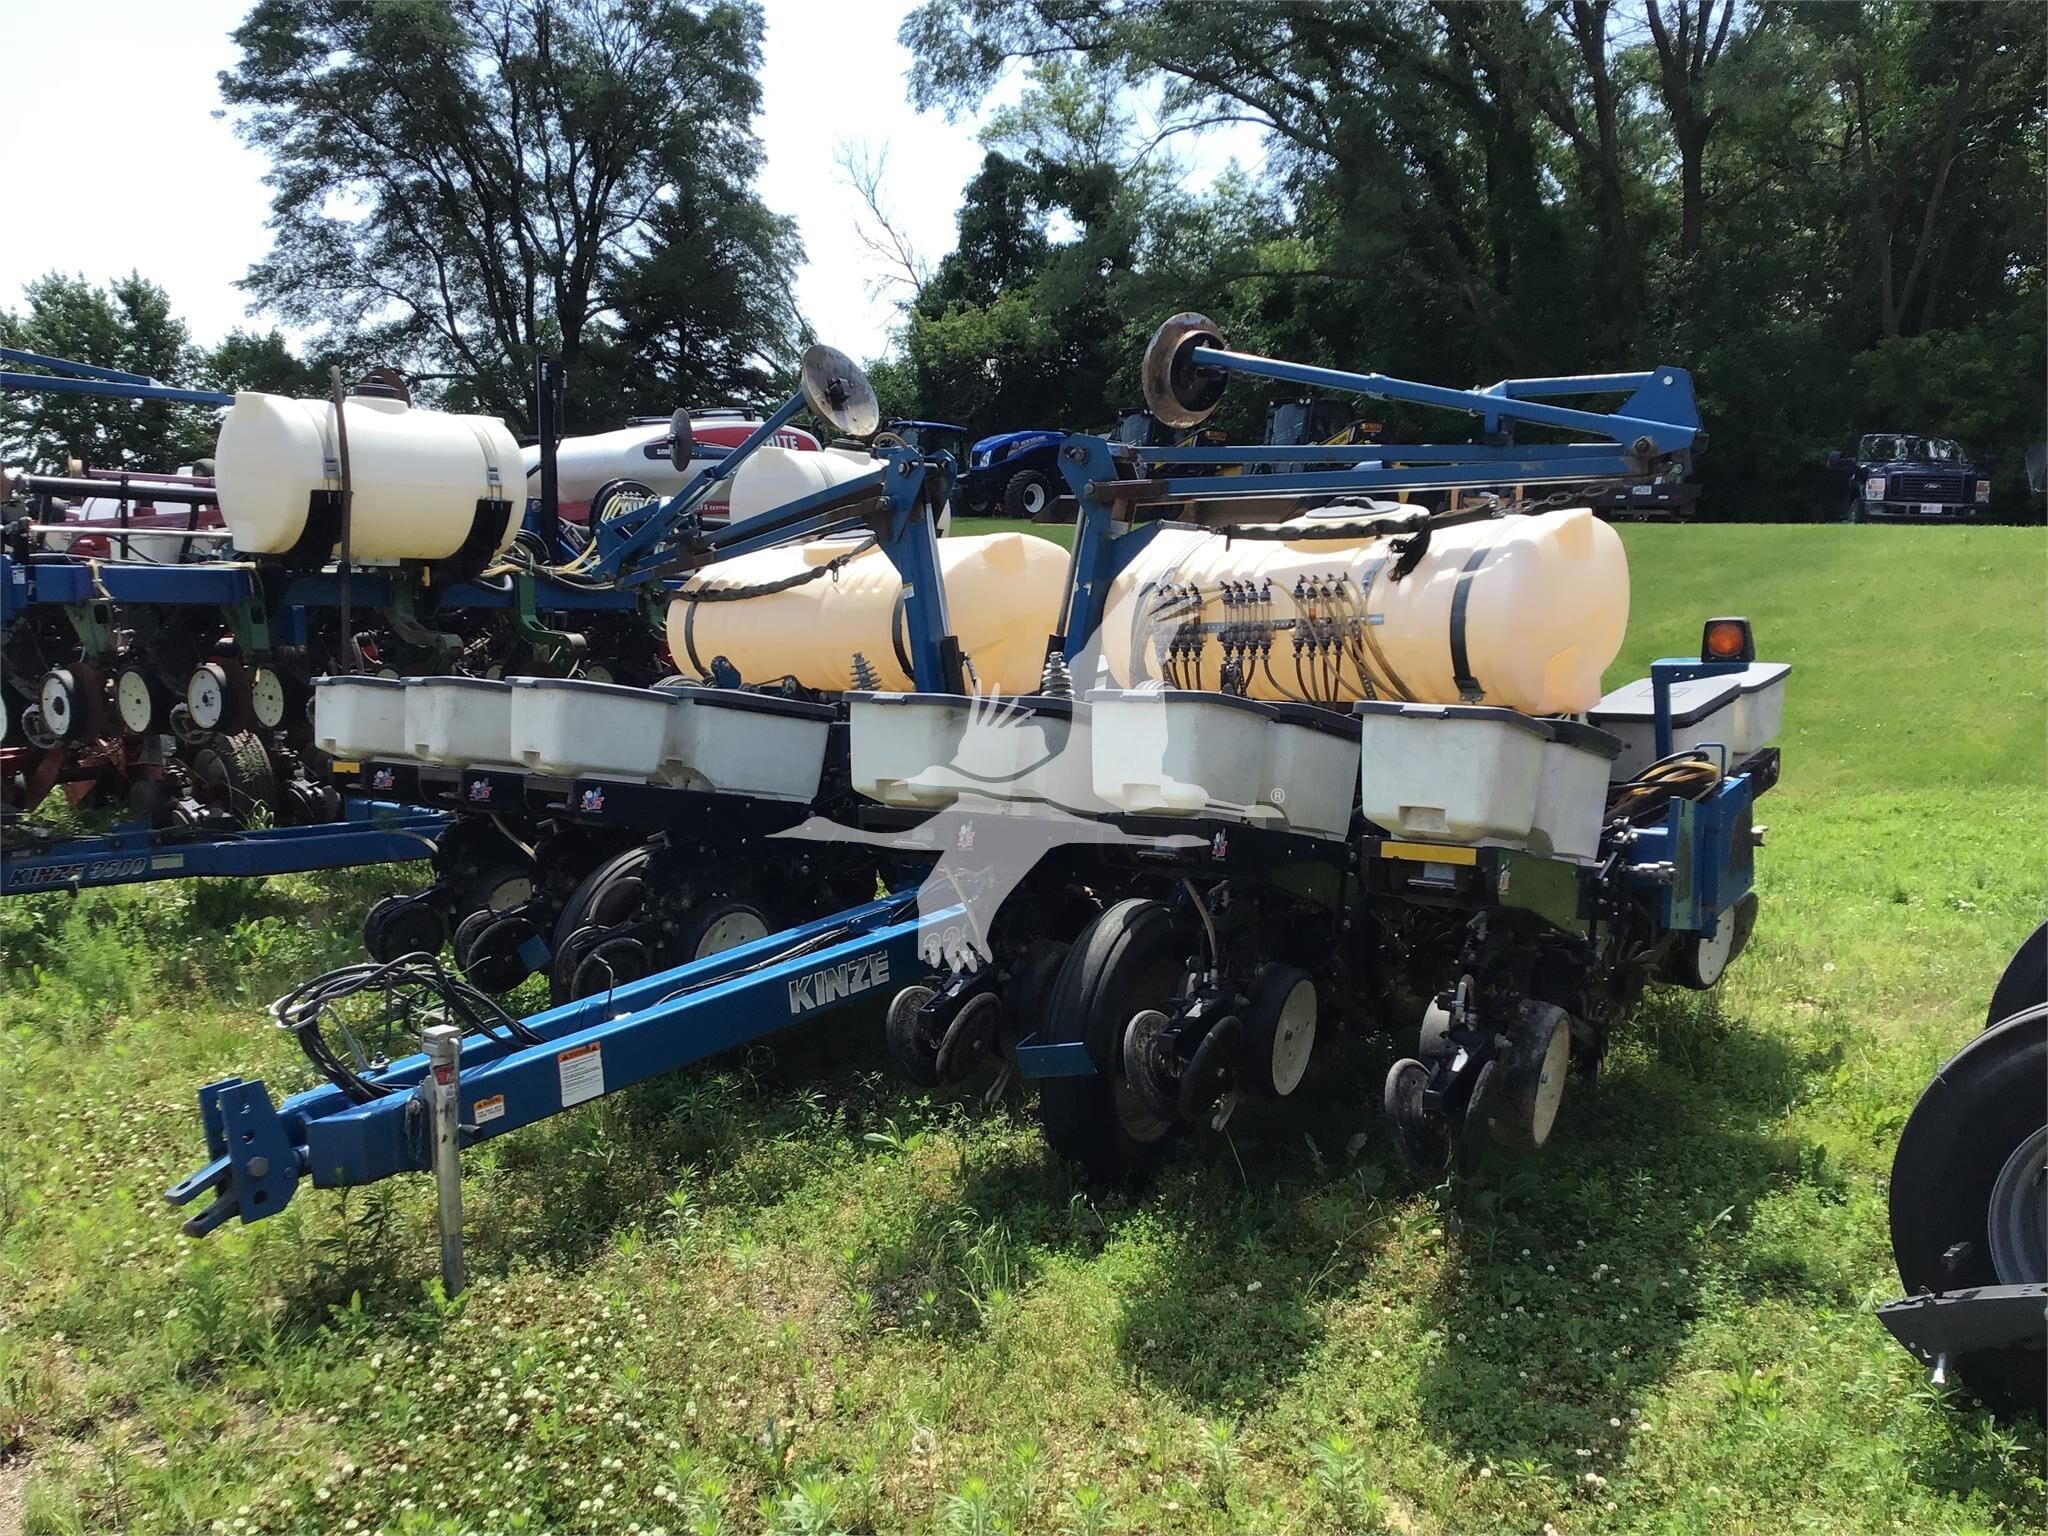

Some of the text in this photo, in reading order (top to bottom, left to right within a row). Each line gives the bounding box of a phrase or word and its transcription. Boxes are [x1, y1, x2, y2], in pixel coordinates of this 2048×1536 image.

[8, 858, 147, 887] KINZE 3500
[788, 949, 890, 1015] KINZE
